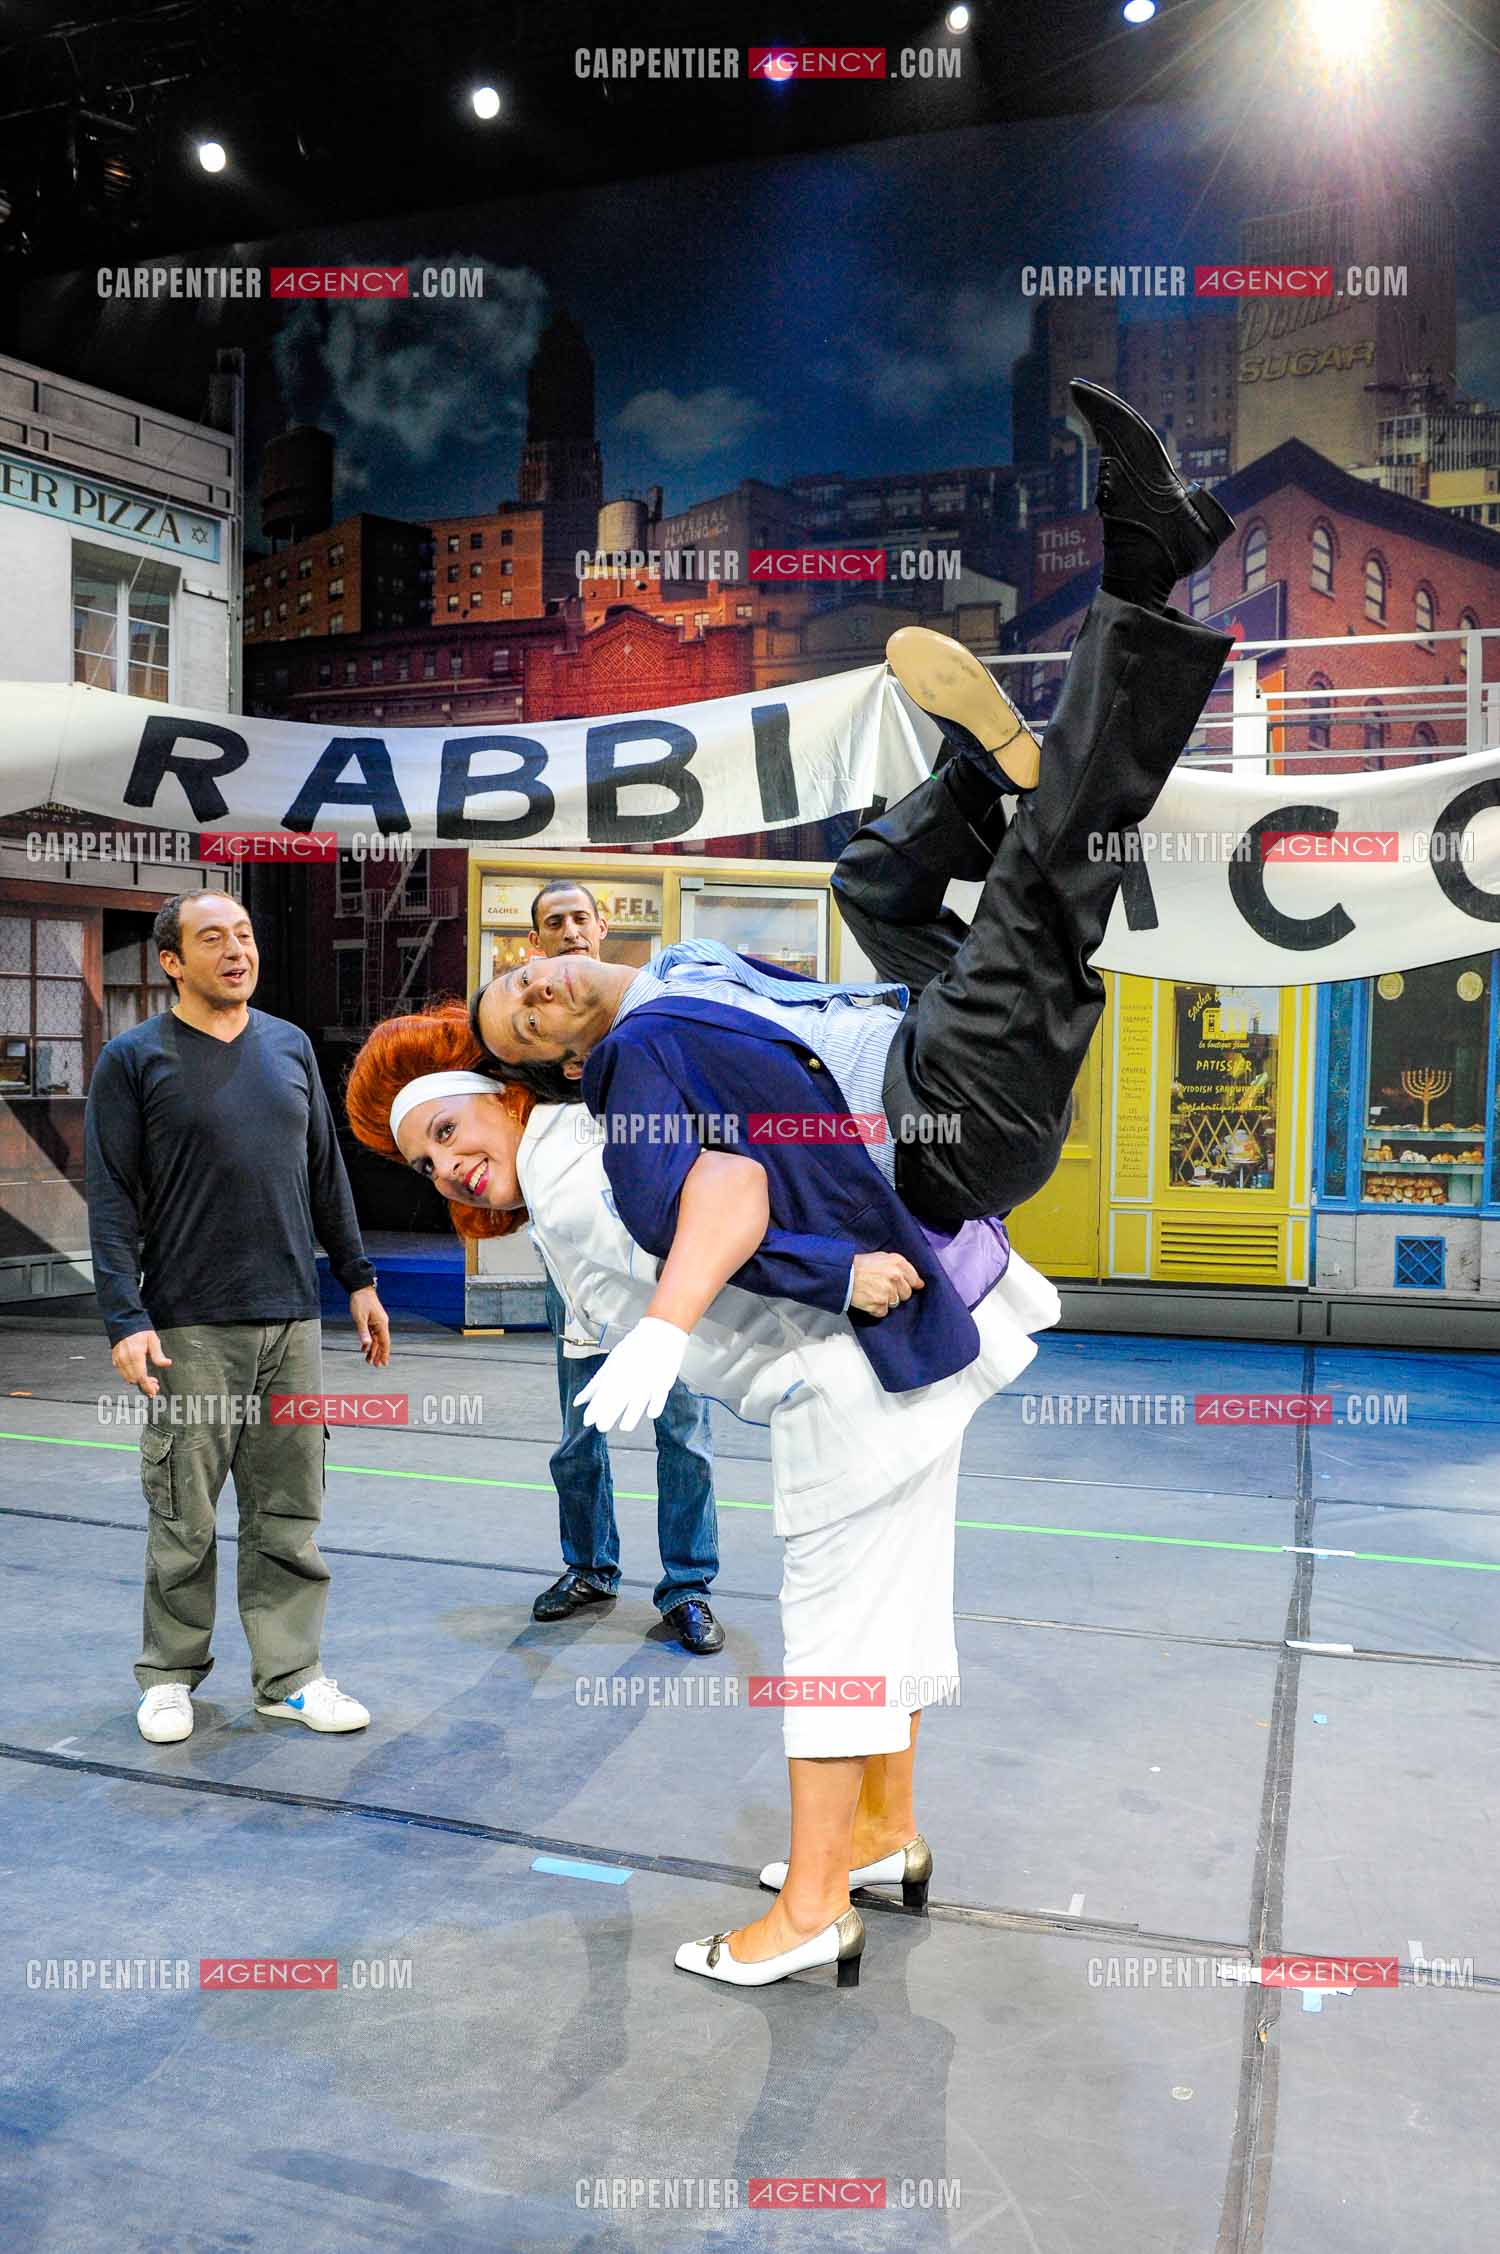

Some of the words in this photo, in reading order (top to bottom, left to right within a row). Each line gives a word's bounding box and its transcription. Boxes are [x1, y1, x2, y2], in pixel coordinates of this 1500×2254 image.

[1237, 340, 1377, 384] SUGAR
[73, 484, 180, 544] PIZZA
[1037, 527, 1086, 550] This.
[1037, 549, 1090, 573] That.
[123, 703, 800, 844] RABBI
